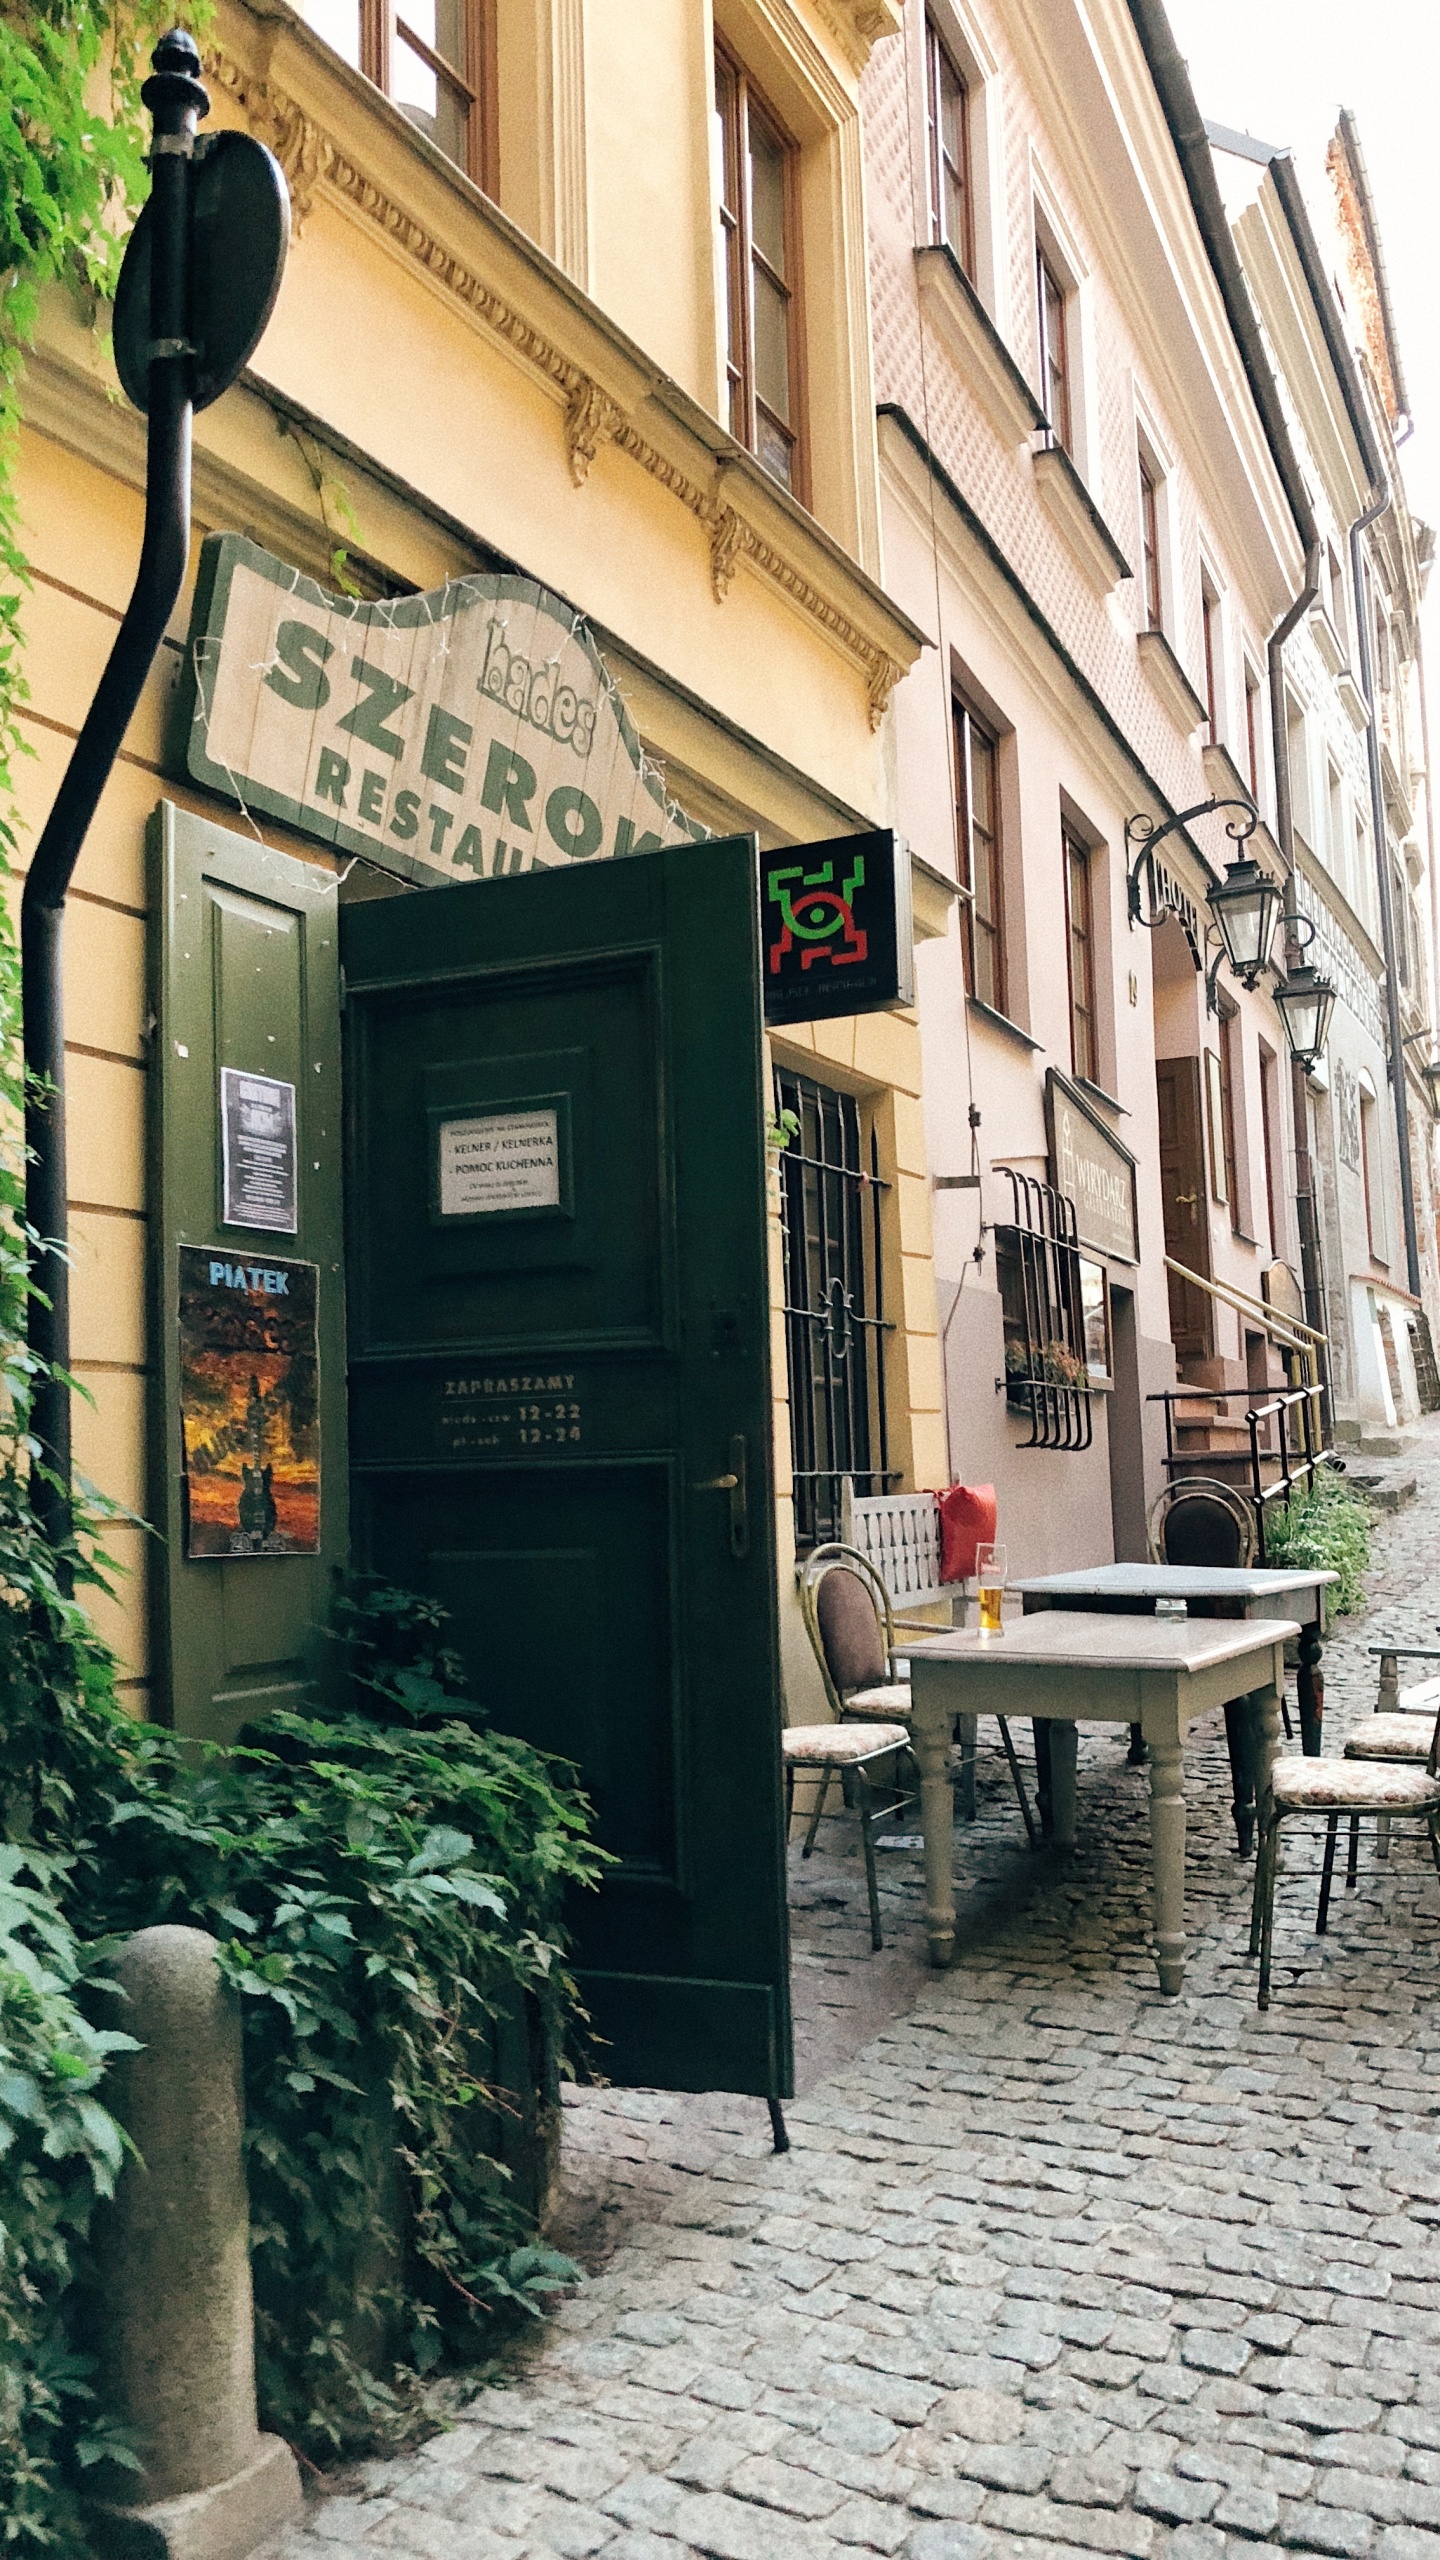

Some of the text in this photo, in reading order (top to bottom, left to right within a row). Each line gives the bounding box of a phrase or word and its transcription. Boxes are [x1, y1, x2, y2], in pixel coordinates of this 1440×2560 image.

[315, 746, 549, 878] RESTAU
[454, 1142, 491, 1154] KELNER
[502, 1136, 554, 1150] KELNERKA
[455, 1157, 554, 1175] POMOC KUCHENNA
[1076, 1153, 1127, 1211] WIRYDARZ
[208, 1260, 290, 1296] PIĄTEK
[444, 1375, 575, 1395] ZAPRASZAMY
